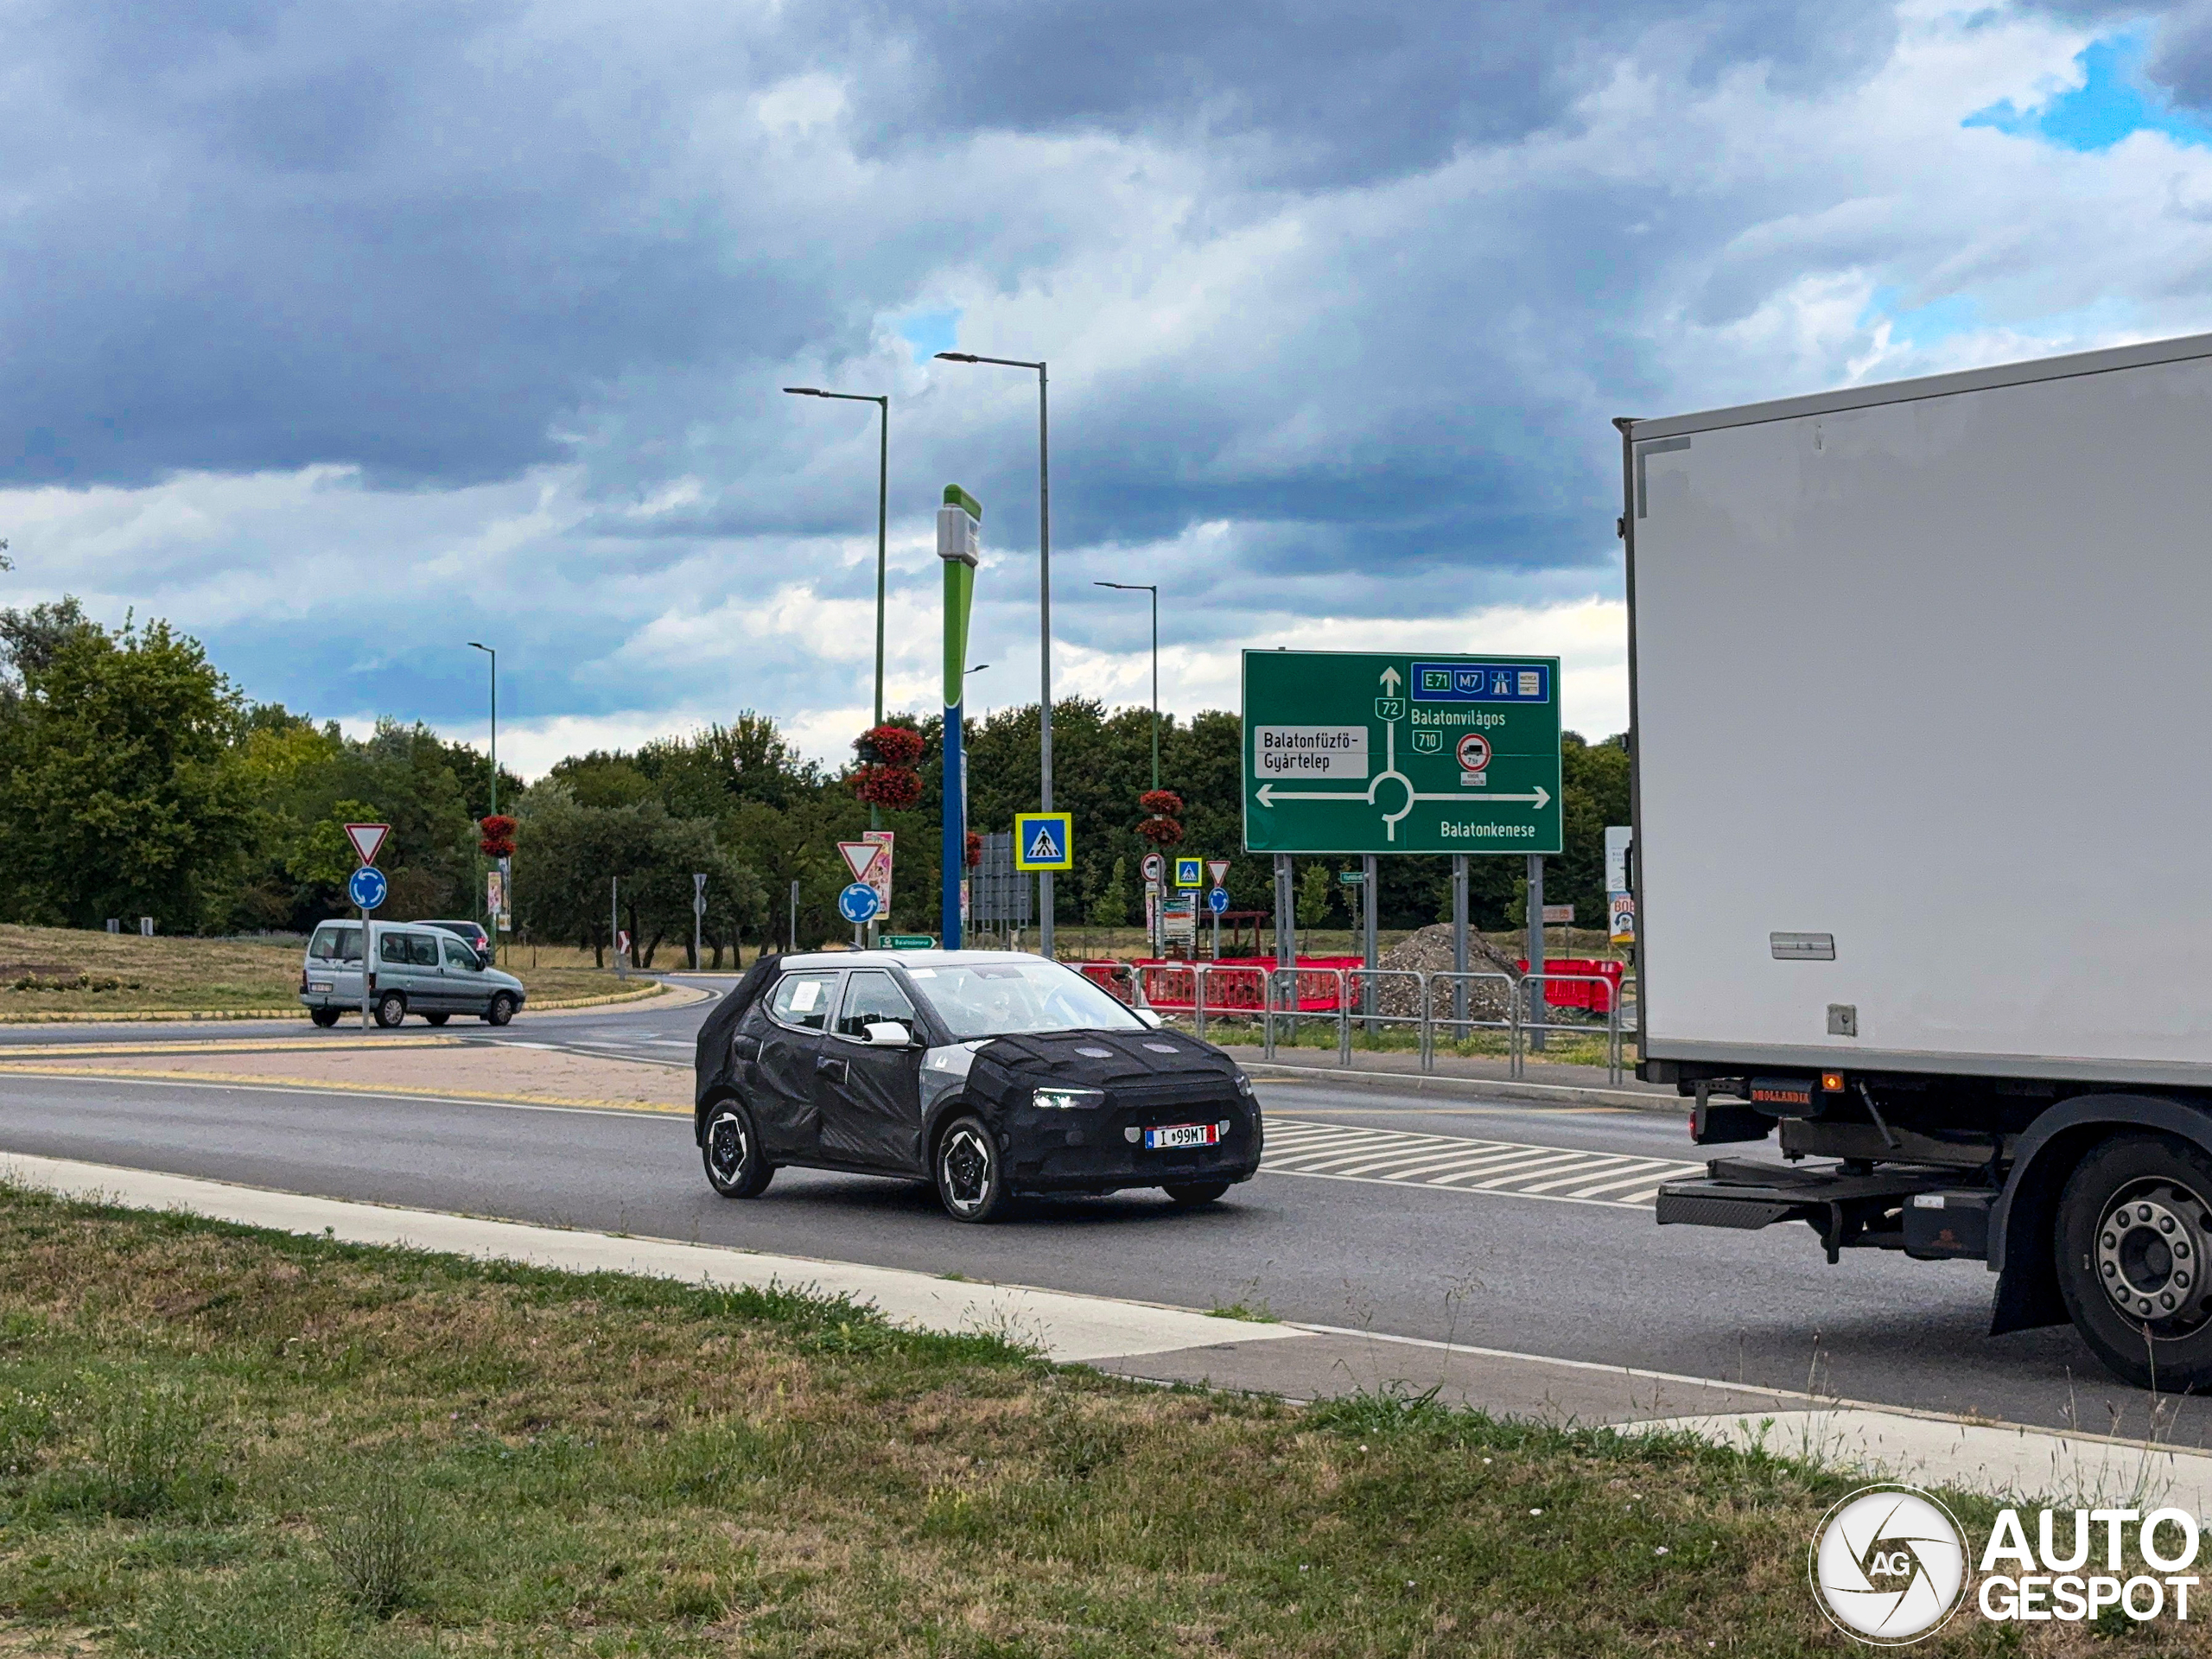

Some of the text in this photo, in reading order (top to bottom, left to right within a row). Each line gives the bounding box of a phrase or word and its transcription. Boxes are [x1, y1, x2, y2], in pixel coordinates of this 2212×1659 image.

[1459, 674, 1478, 688] M7
[1382, 702, 1398, 715] 72
[1411, 709, 1506, 730] Balatonvilágos
[1419, 734, 1437, 748] 710
[1264, 753, 1331, 772] Gyártelep
[1440, 821, 1535, 838] Balatonkenese
